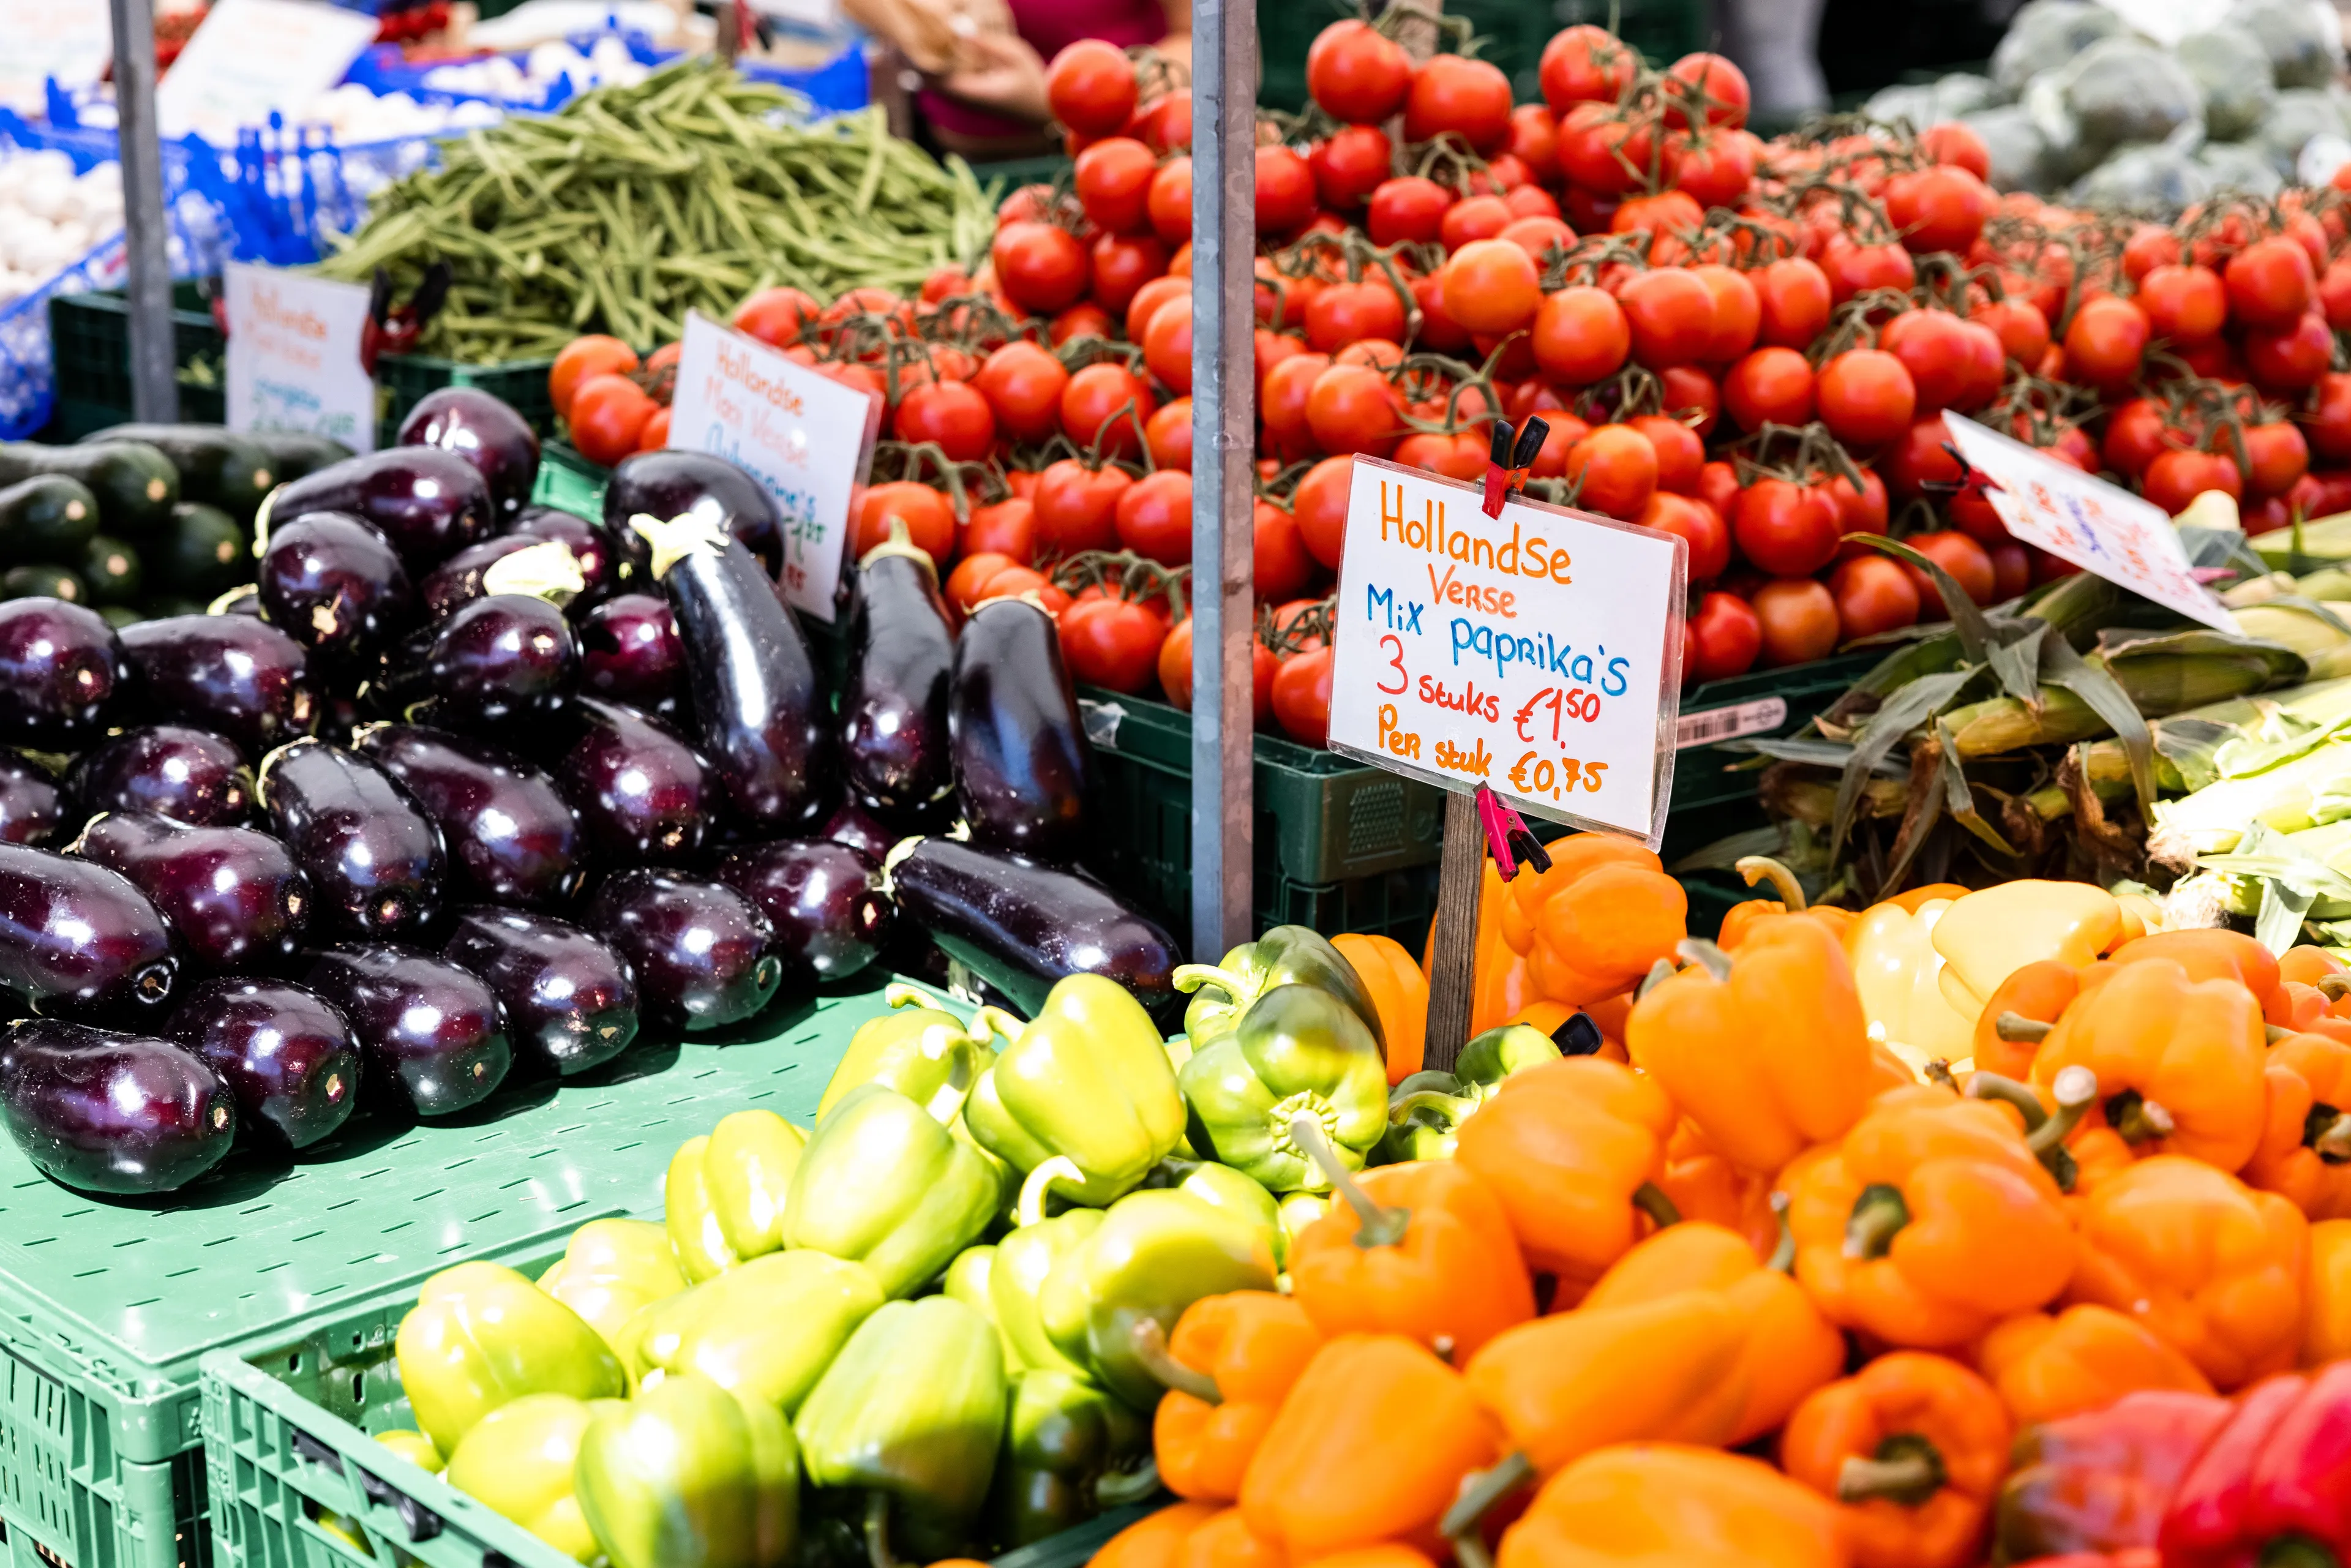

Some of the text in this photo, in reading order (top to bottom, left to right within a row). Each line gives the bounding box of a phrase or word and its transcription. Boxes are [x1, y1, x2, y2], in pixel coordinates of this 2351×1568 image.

[1368, 583, 1423, 635] Mix
[1377, 634, 1408, 694] 3
[1419, 675, 1499, 722] stuks
[1379, 704, 1608, 801] Per stuk €0,75
